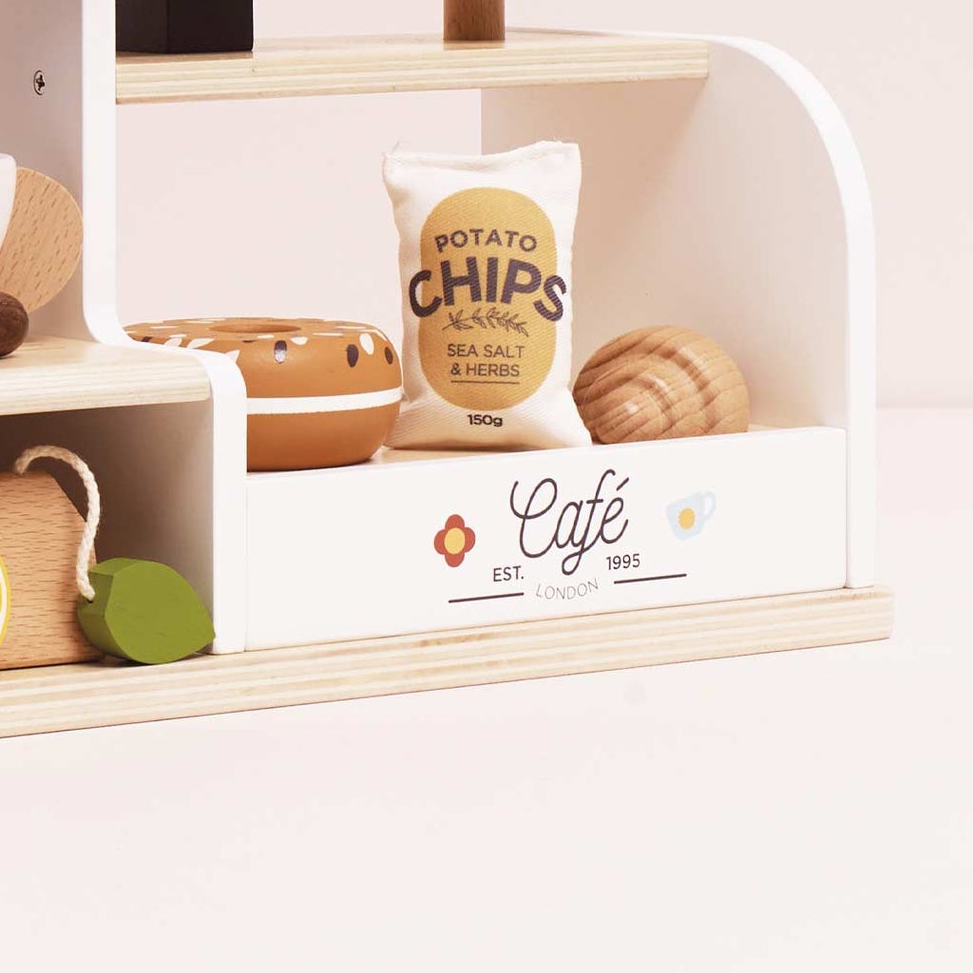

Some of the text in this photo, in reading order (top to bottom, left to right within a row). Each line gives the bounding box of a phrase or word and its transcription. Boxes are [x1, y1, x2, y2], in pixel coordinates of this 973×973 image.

[433, 228, 538, 254] POTATO
[408, 256, 568, 322] CHIPS
[447, 343, 525, 359] SEA SALT
[450, 362, 520, 377] & HERBS
[467, 414, 503, 428] 150g
[510, 469, 629, 576] Café
[492, 553, 641, 582] EST. 1995
[535, 578, 599, 601] LONDON
